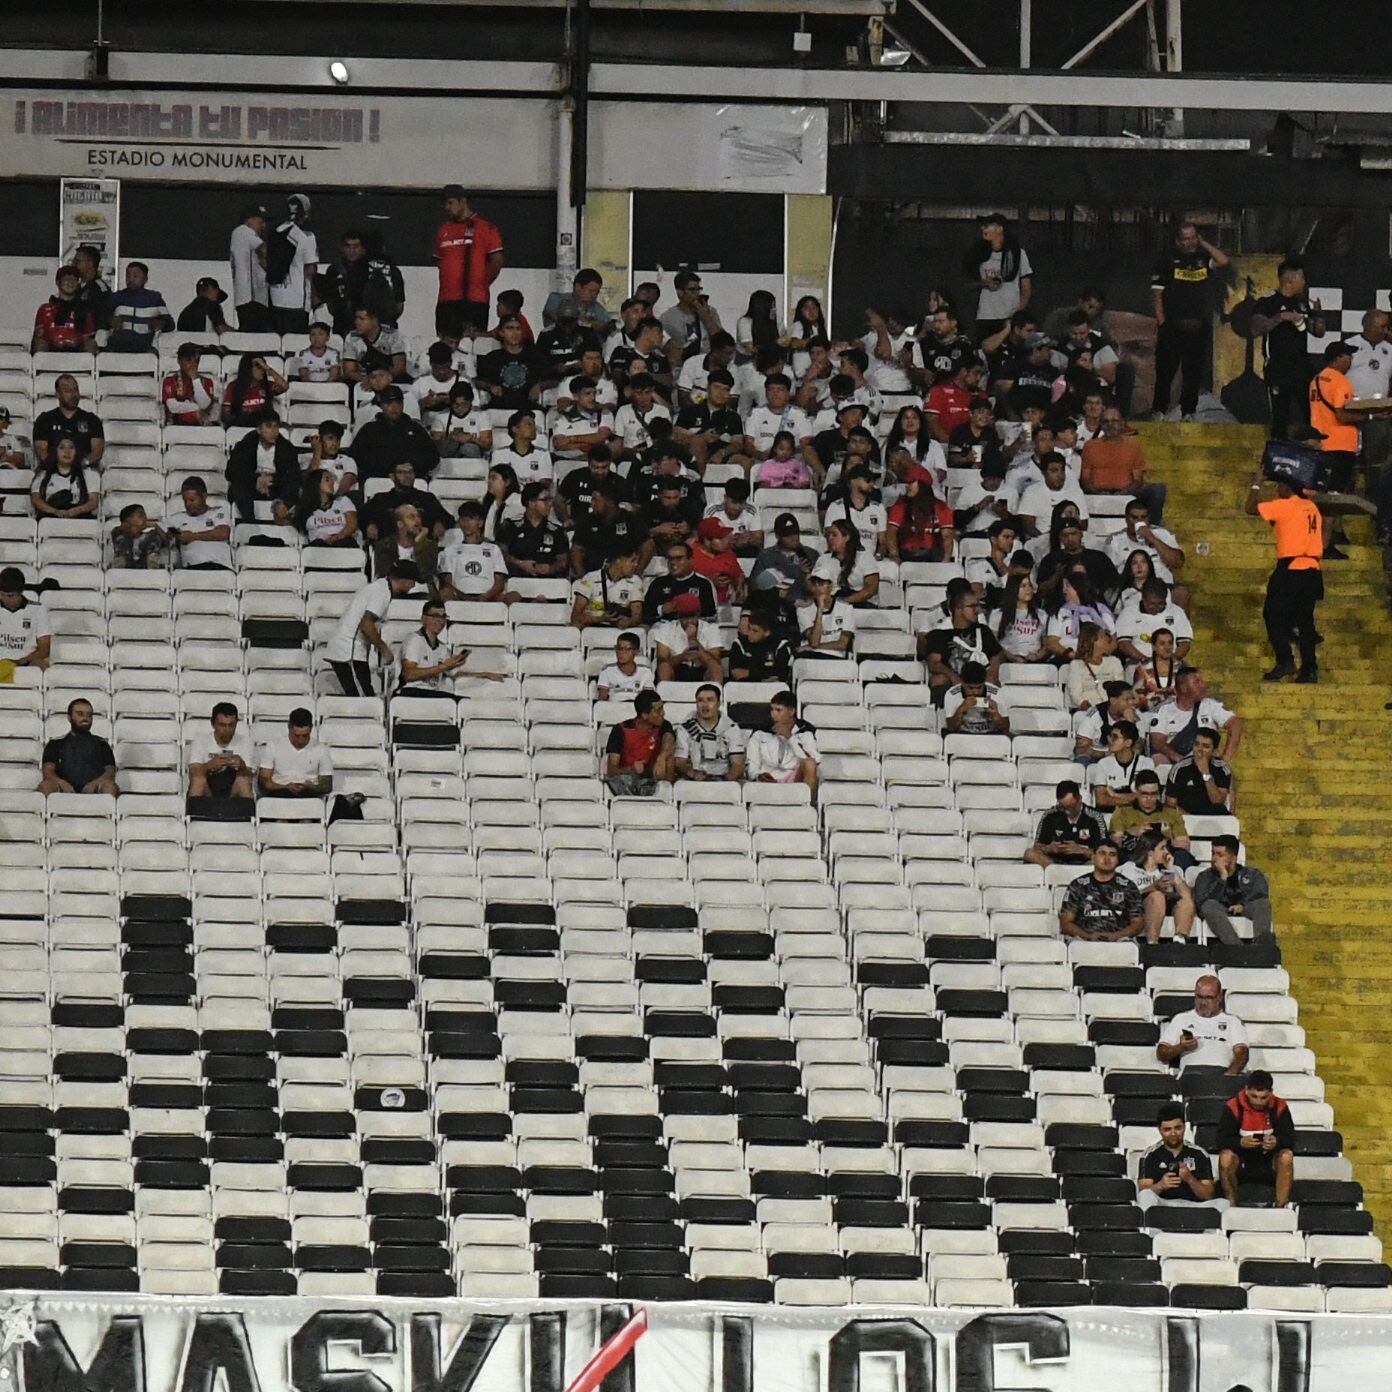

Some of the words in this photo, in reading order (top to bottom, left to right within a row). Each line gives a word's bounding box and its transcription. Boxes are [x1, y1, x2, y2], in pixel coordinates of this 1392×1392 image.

[88, 150, 165, 167] ESTADIO
[172, 153, 308, 170] MONUMENTAL
[1307, 514, 1318, 535] 14
